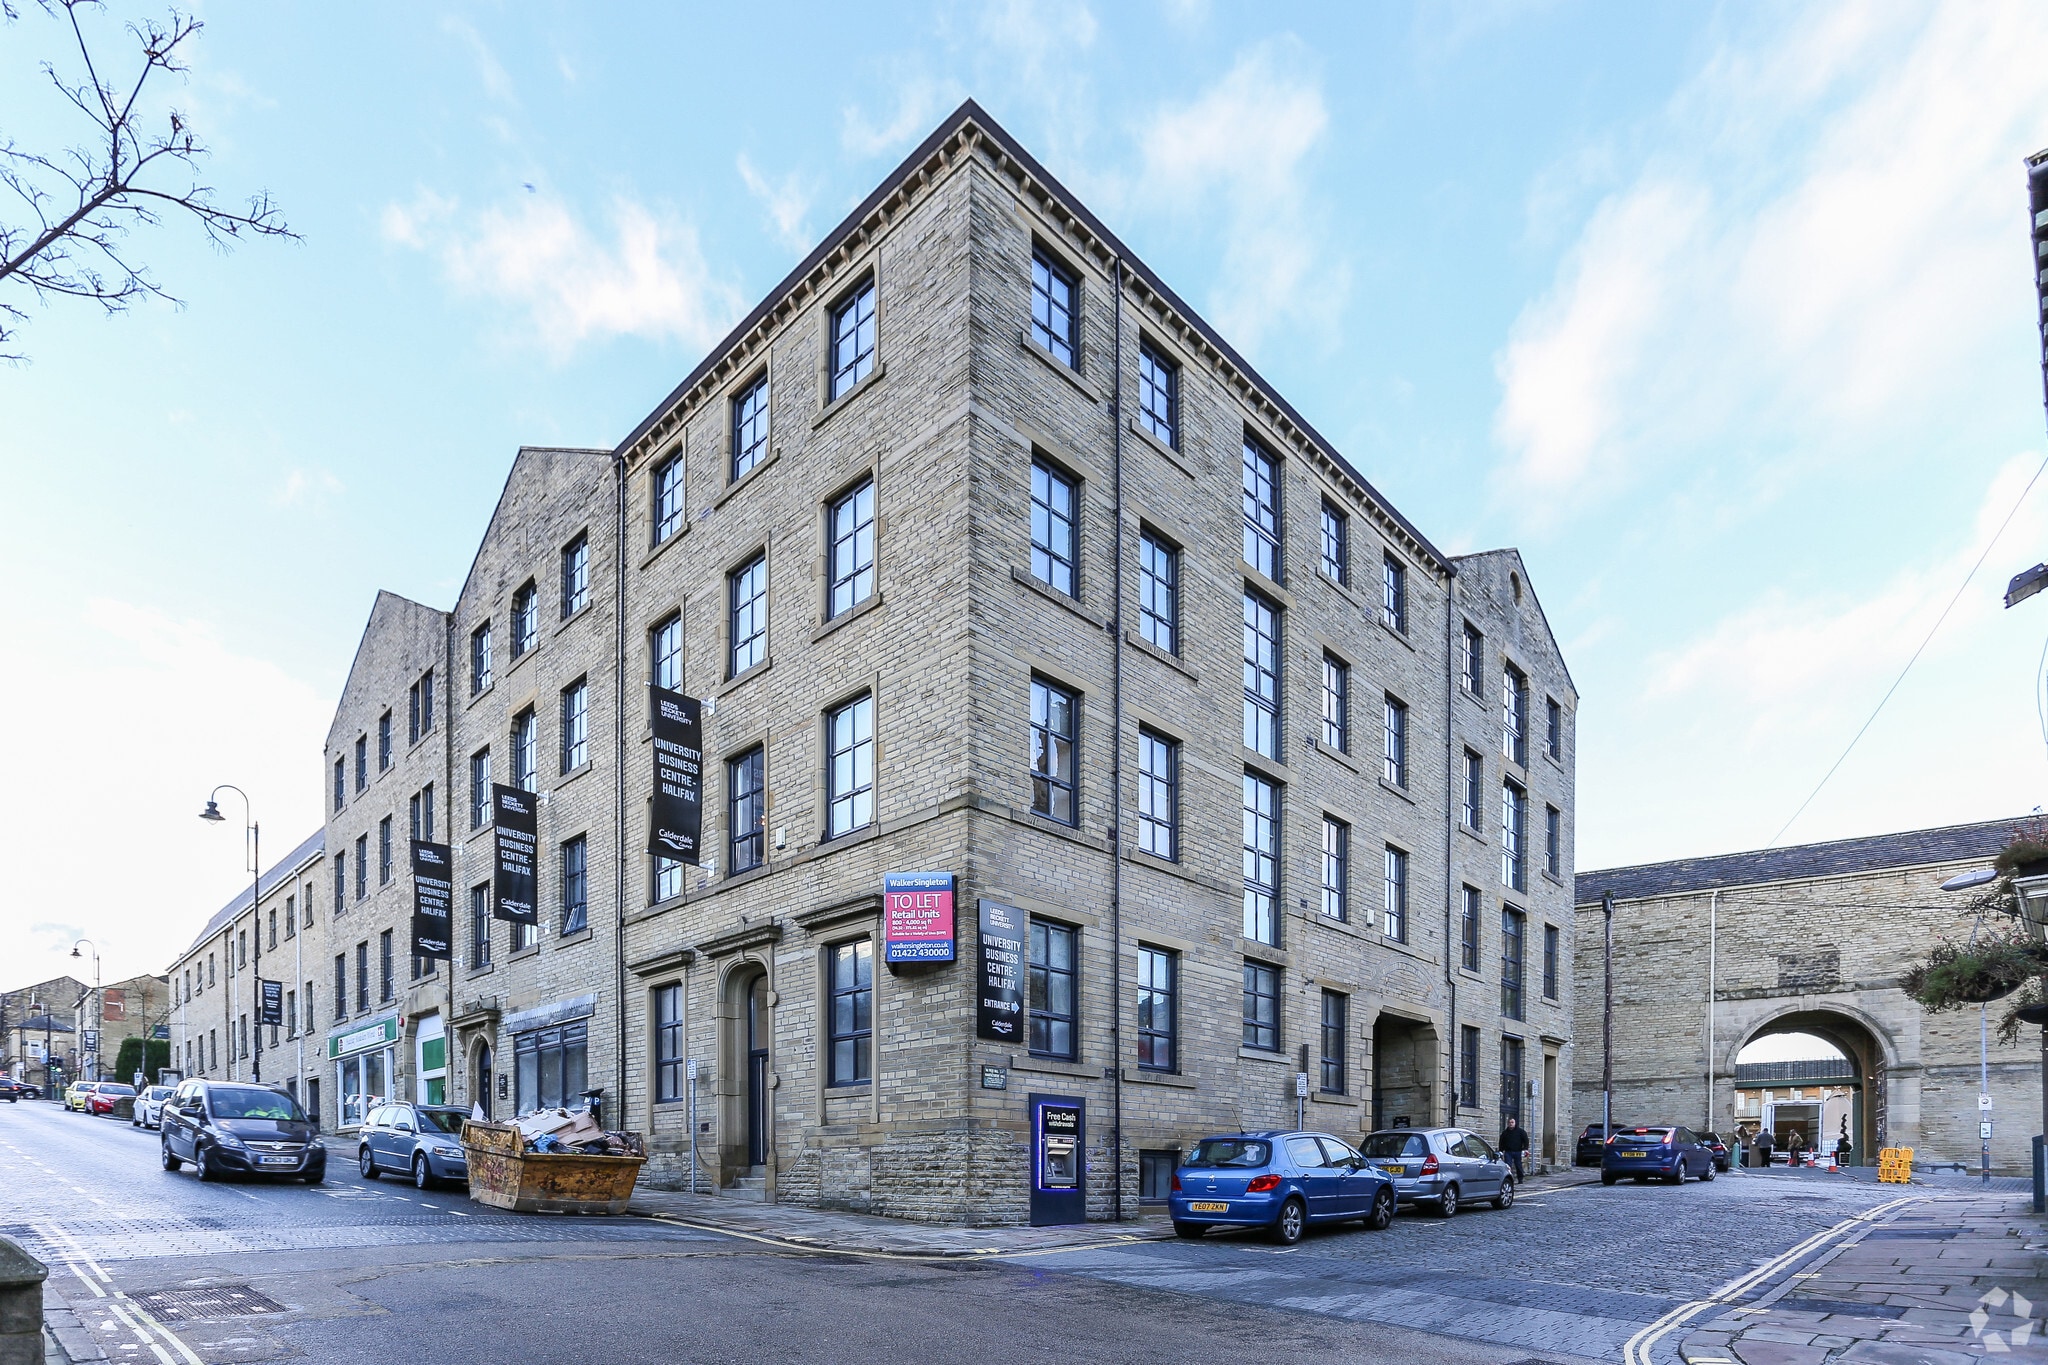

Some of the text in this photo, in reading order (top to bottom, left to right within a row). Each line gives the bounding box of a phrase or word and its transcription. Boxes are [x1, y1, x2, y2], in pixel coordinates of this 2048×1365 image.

[660, 700, 678, 710] LEEDS
[661, 706, 685, 717] BECKETT
[661, 711, 692, 725] UNIVERSITY
[655, 737, 701, 761] UNIVERSITY
[659, 753, 698, 774] BUSINESS
[663, 783, 695, 802] HALIFAX
[497, 826, 536, 843] UNIVERSITY
[659, 828, 693, 844] Calderdale
[500, 838, 533, 854] BUSINESS
[503, 862, 530, 876] HALIFAX
[416, 875, 450, 889] UNIVERSITY
[890, 879, 948, 888] WalkerSingleton
[419, 886, 449, 899] BUSINESS
[501, 898, 531, 909] Calderdale
[891, 893, 942, 909] TO LET
[421, 906, 446, 918] HALIFAX
[892, 909, 940, 919] Retail Units
[990, 919, 1014, 930] UNIVERSITY
[892, 941, 949, 951] walkersingleton.co.uk
[983, 934, 1020, 952] UNIVERSITY
[892, 948, 949, 958] 01422 430000
[986, 948, 1018, 964] BUSINESS
[989, 975, 1015, 990] HALIFAX
[984, 999, 1010, 1010] ENTRANCE
[594, 1097, 600, 1105] P
[1047, 1111, 1076, 1122] Free Cash
[1048, 1120, 1074, 1128] withdrawals
[1194, 1202, 1210, 1210] YE07
